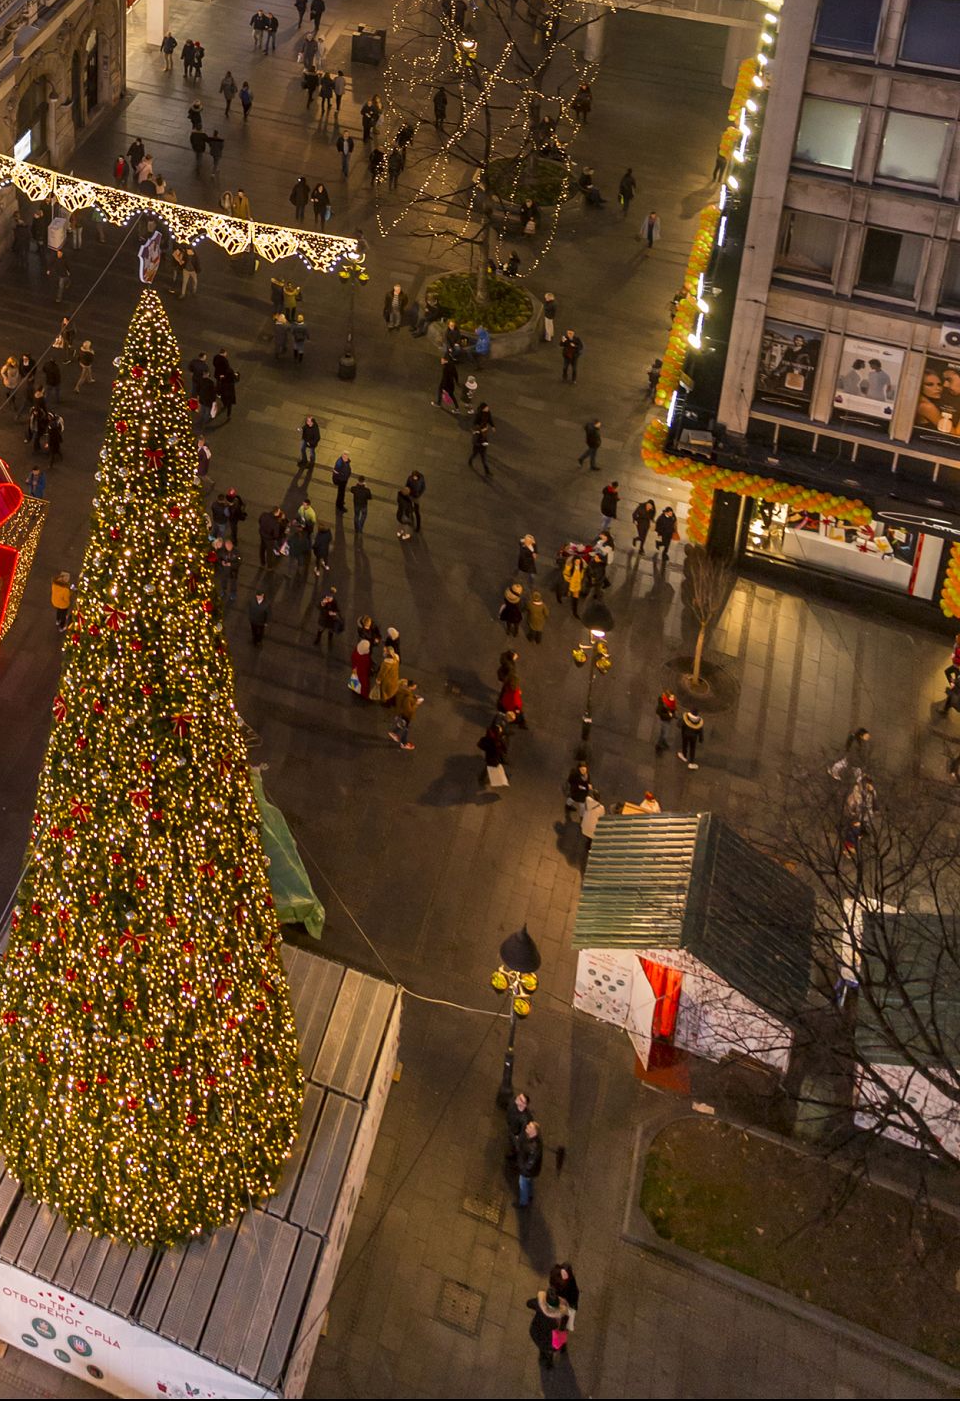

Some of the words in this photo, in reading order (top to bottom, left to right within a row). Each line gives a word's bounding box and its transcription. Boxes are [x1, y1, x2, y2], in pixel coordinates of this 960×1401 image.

[2, 1287, 83, 1328] ОТВОРЕНОГ
[85, 1325, 121, 1350] СРЦА
[50, 1300, 74, 1315] ТРГ
